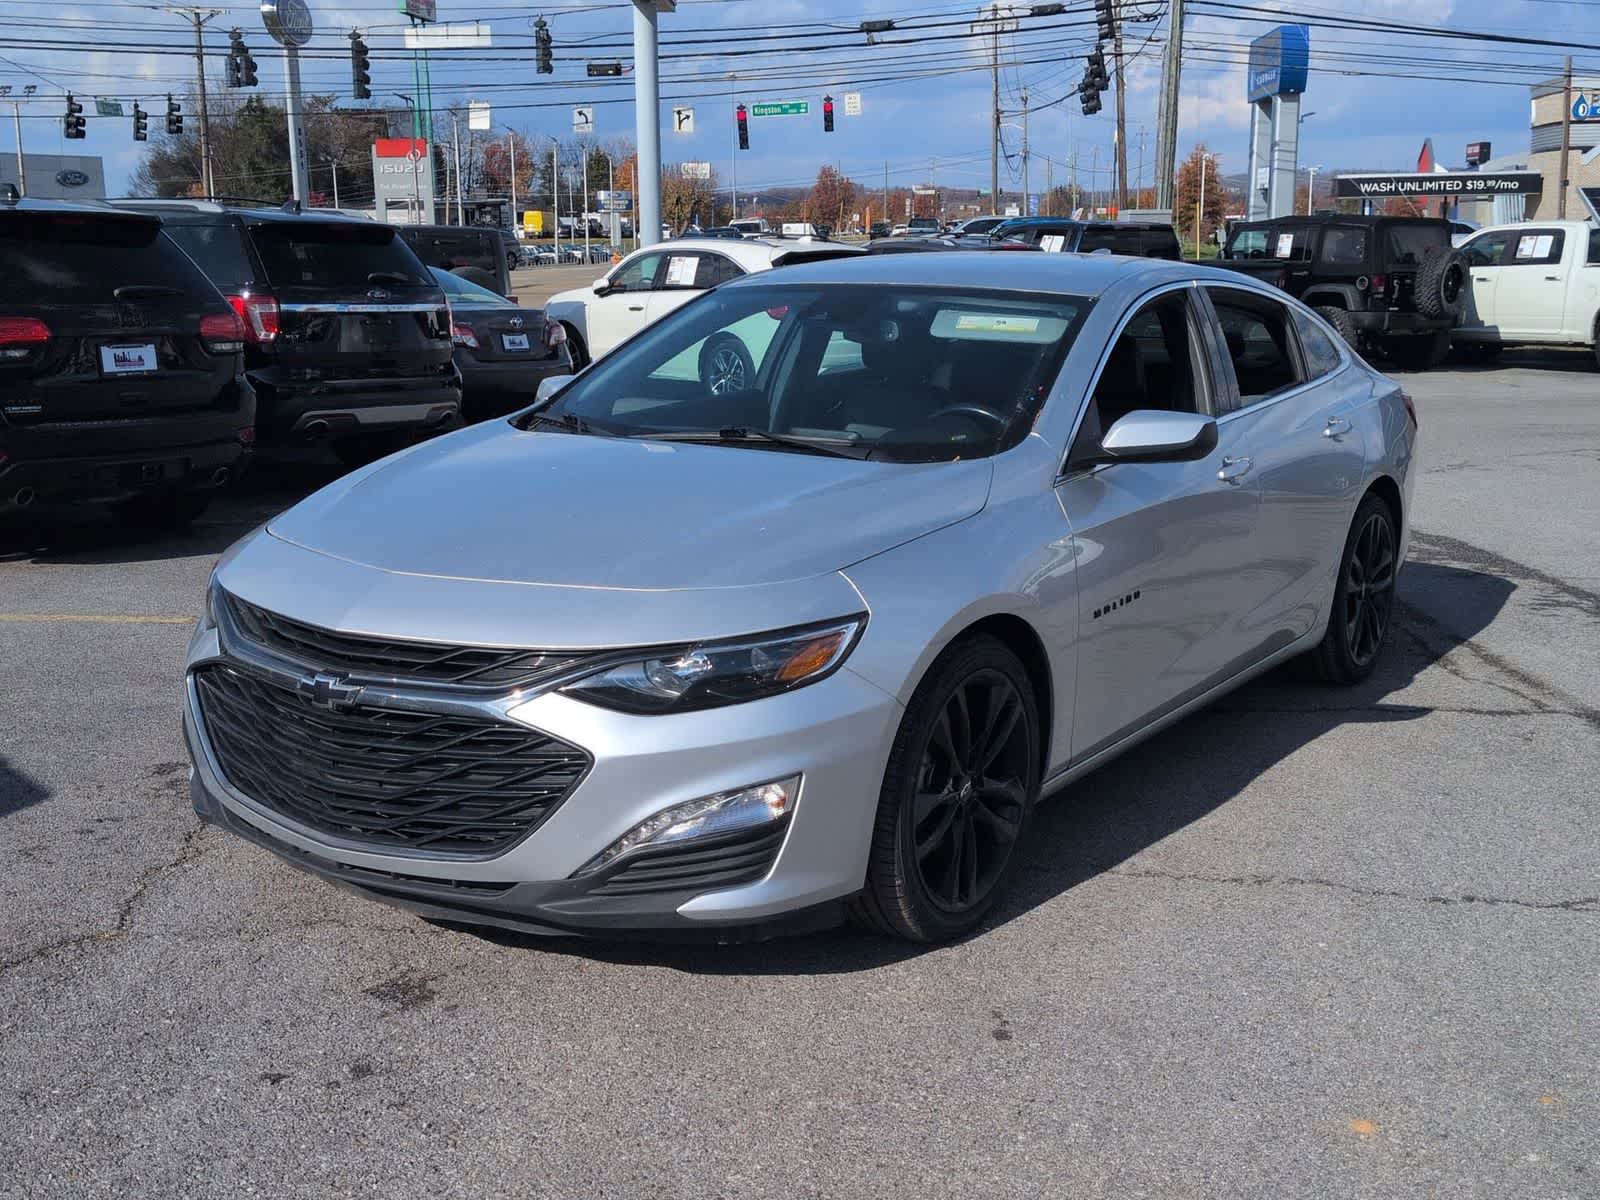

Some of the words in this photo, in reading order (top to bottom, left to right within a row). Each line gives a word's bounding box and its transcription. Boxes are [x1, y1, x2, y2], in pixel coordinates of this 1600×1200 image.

[753, 105, 782, 115] Kingston
[380, 163, 425, 173] ISUZU
[1360, 182, 1395, 193] WASH
[1398, 180, 1463, 192] UNLIMITED
[1465, 179, 1520, 190] $19.99/mo
[1093, 590, 1140, 619] MALIBU
